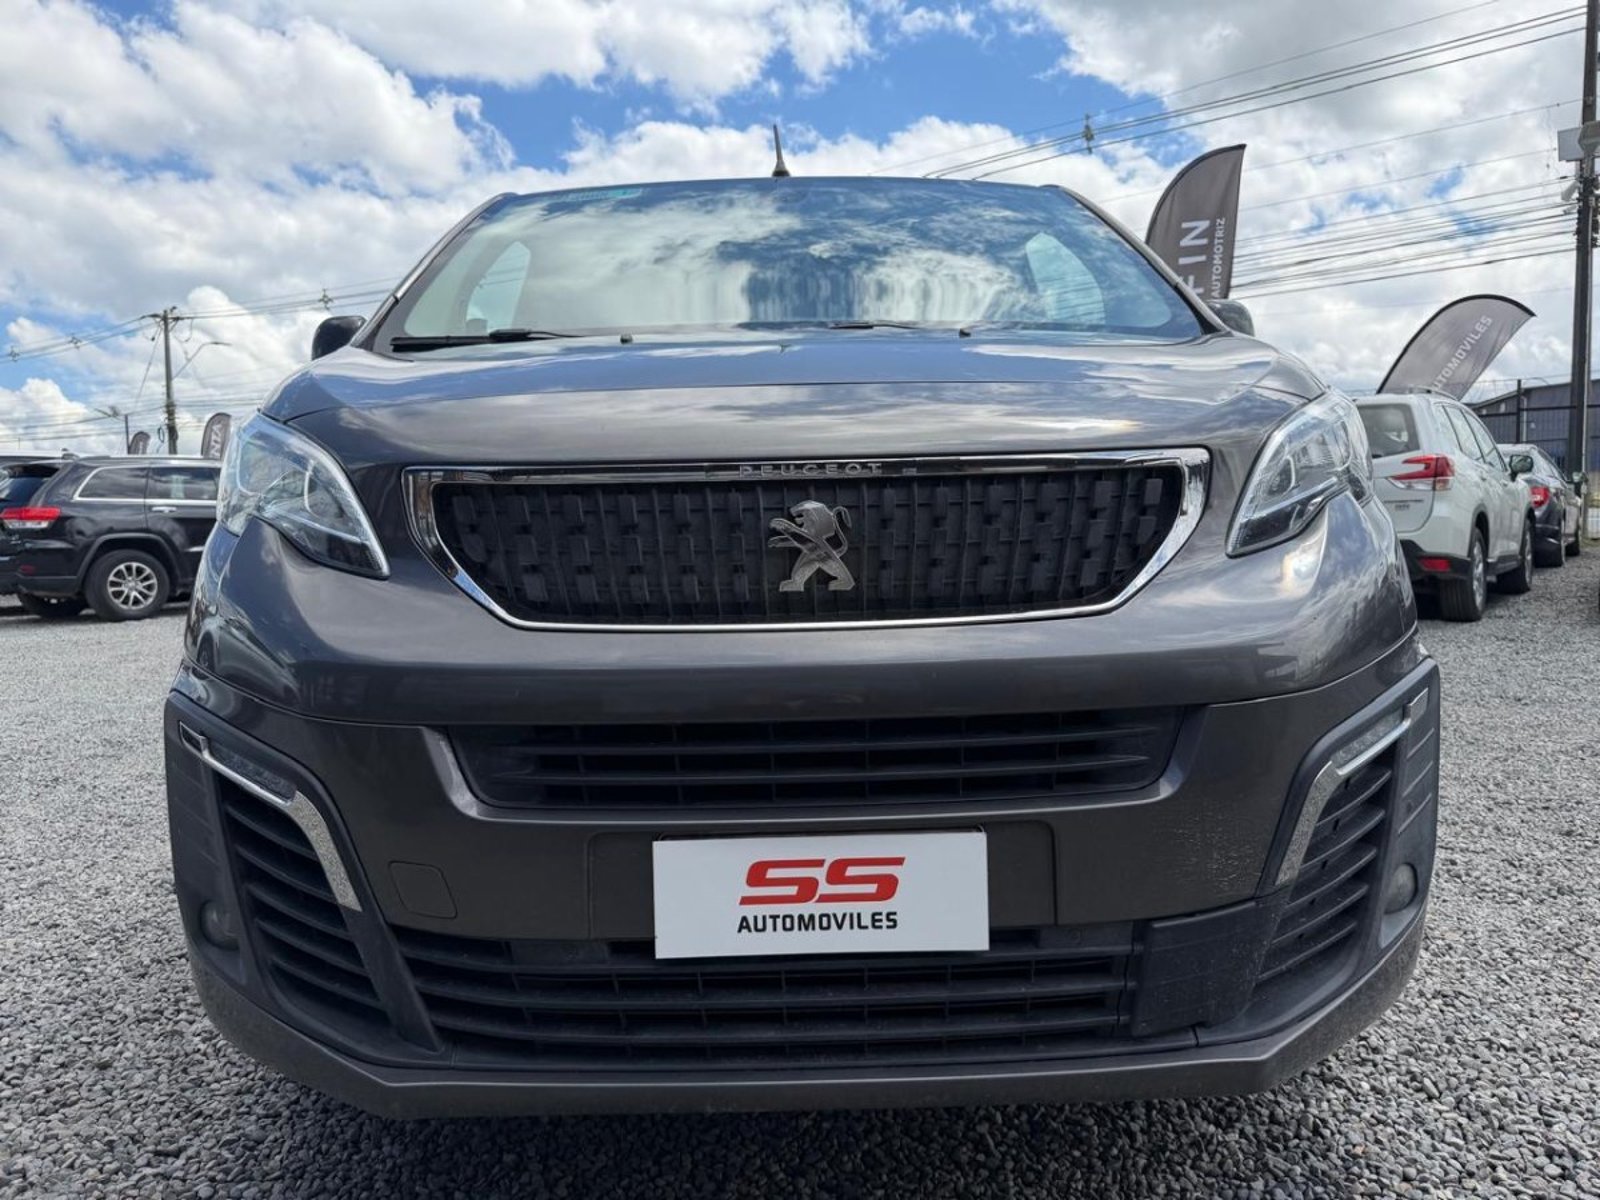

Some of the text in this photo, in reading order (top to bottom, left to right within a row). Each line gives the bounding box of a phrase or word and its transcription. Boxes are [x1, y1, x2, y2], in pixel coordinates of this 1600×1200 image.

[1211, 217, 1225, 298] AUTOMOTRIZ
[1432, 315, 1493, 390] UTOMOVILES
[739, 463, 882, 477] PEUGEOT
[738, 856, 906, 906] SS
[737, 911, 898, 933] AUTOMOVILES
